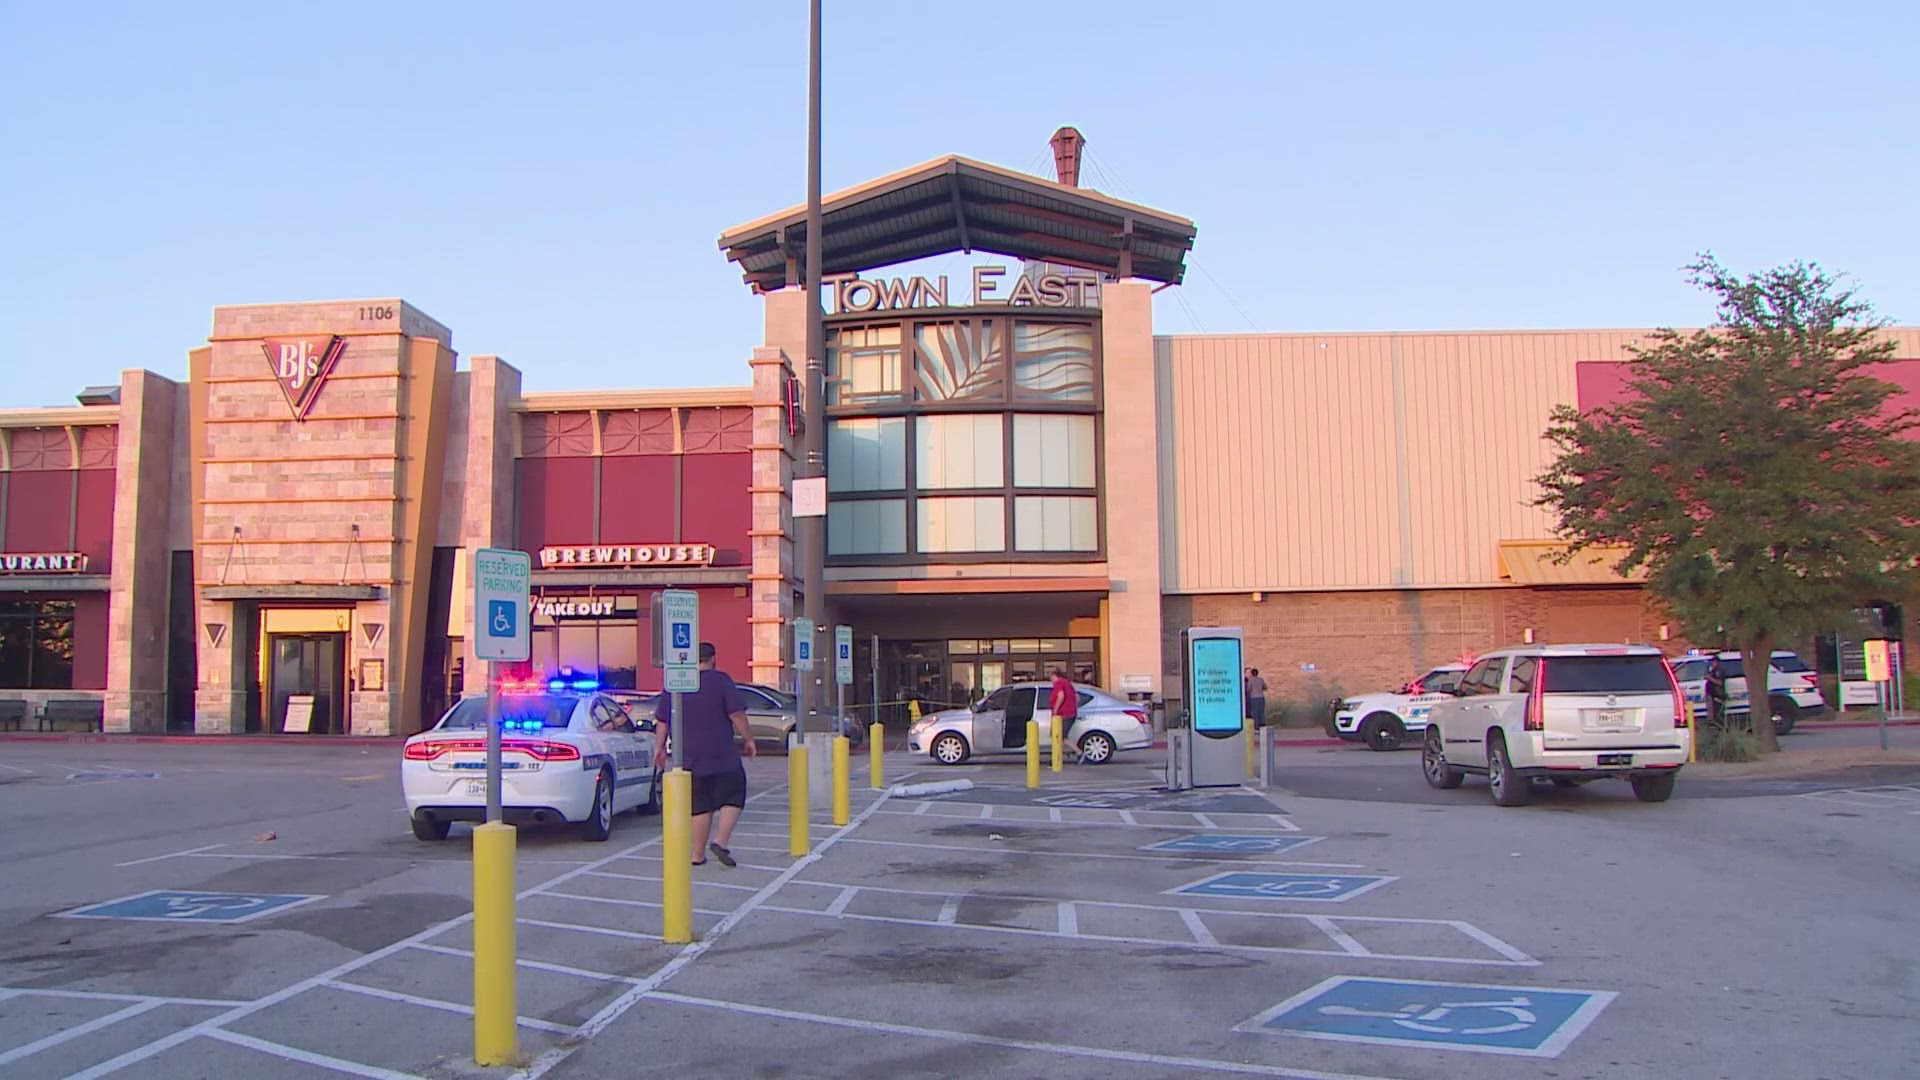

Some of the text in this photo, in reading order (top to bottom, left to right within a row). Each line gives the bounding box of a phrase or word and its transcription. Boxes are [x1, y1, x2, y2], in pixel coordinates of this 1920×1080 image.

[822, 266, 1099, 313] TOWN EAST
[359, 306, 393, 321] 1106
[278, 340, 318, 389] BJ's
[0, 555, 75, 570] URANT
[545, 546, 704, 564] BREWHOUSE
[479, 560, 526, 577] RESERVED
[483, 577, 522, 594] PARKING
[536, 601, 613, 616] TAKE OUT
[665, 596, 696, 608] RESERVED
[667, 608, 694, 620] PARKING
